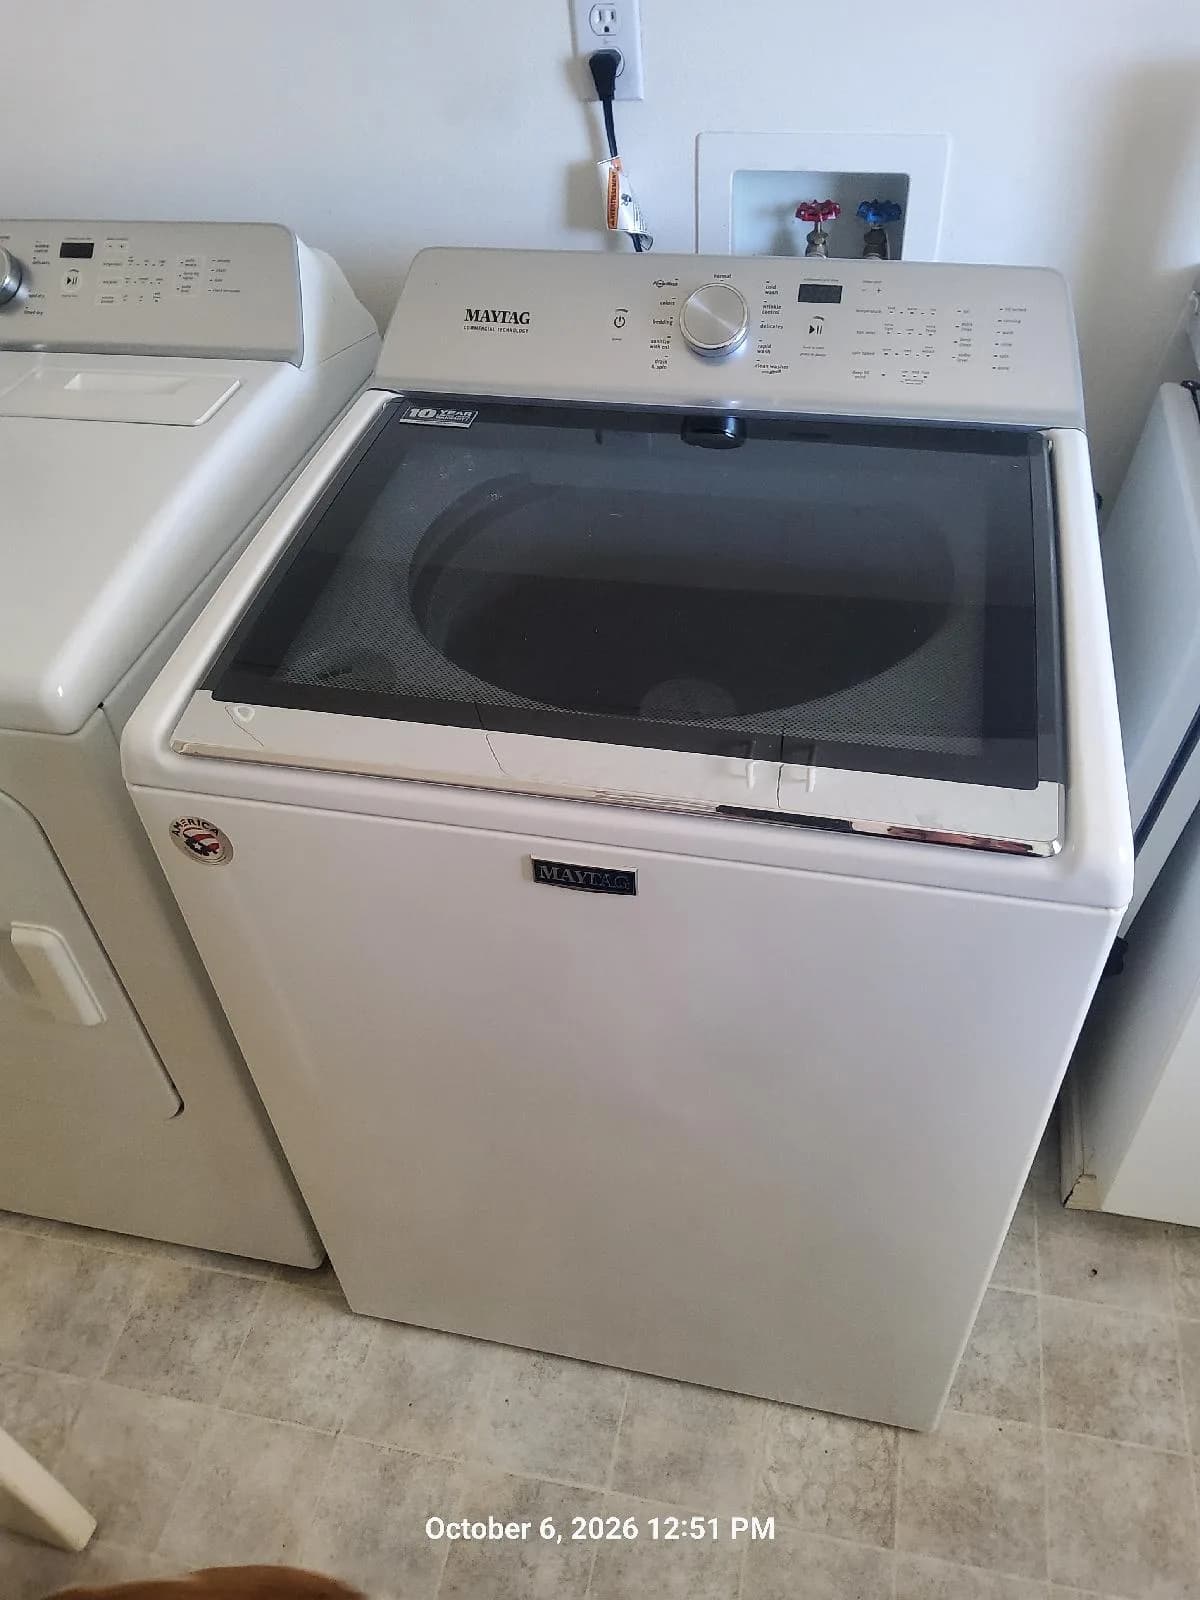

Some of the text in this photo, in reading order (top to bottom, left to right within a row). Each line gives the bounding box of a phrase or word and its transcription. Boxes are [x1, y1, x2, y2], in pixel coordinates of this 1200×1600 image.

[464, 308, 531, 325] MAYTAG
[408, 408, 473, 418] 10 YEAR
[171, 818, 219, 838] AMERICA
[539, 865, 631, 890] MAYTAG
